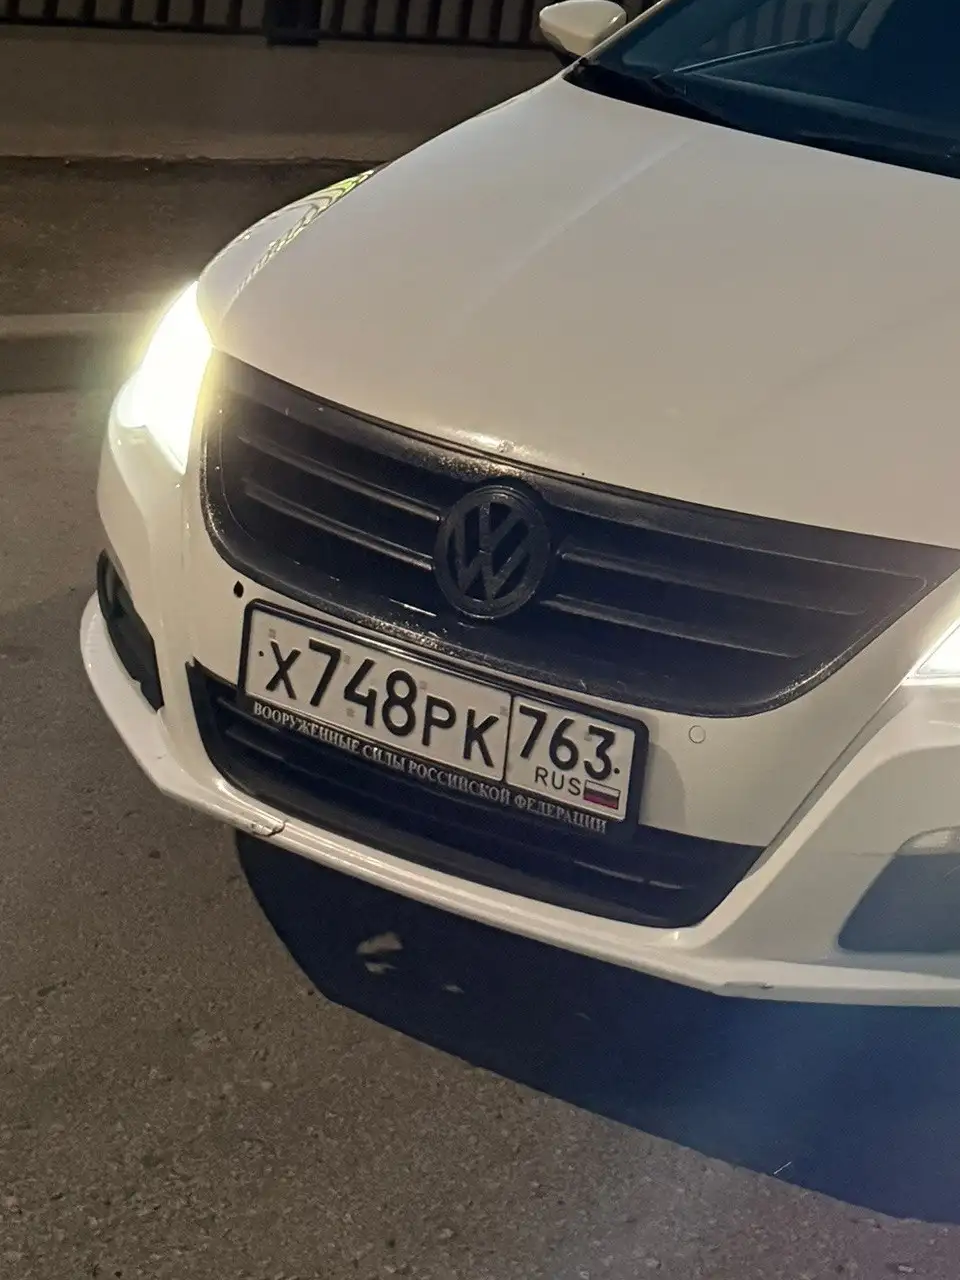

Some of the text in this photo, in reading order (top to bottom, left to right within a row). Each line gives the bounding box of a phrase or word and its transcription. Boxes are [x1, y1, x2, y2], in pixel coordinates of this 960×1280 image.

[253, 701, 608, 836] ВООРУЖЕННЫЕ СИЛЫ РОССИЙСКОЙ ФЕДЕРАЦИИ
[518, 704, 615, 781] 763
[534, 765, 582, 797] RUS
